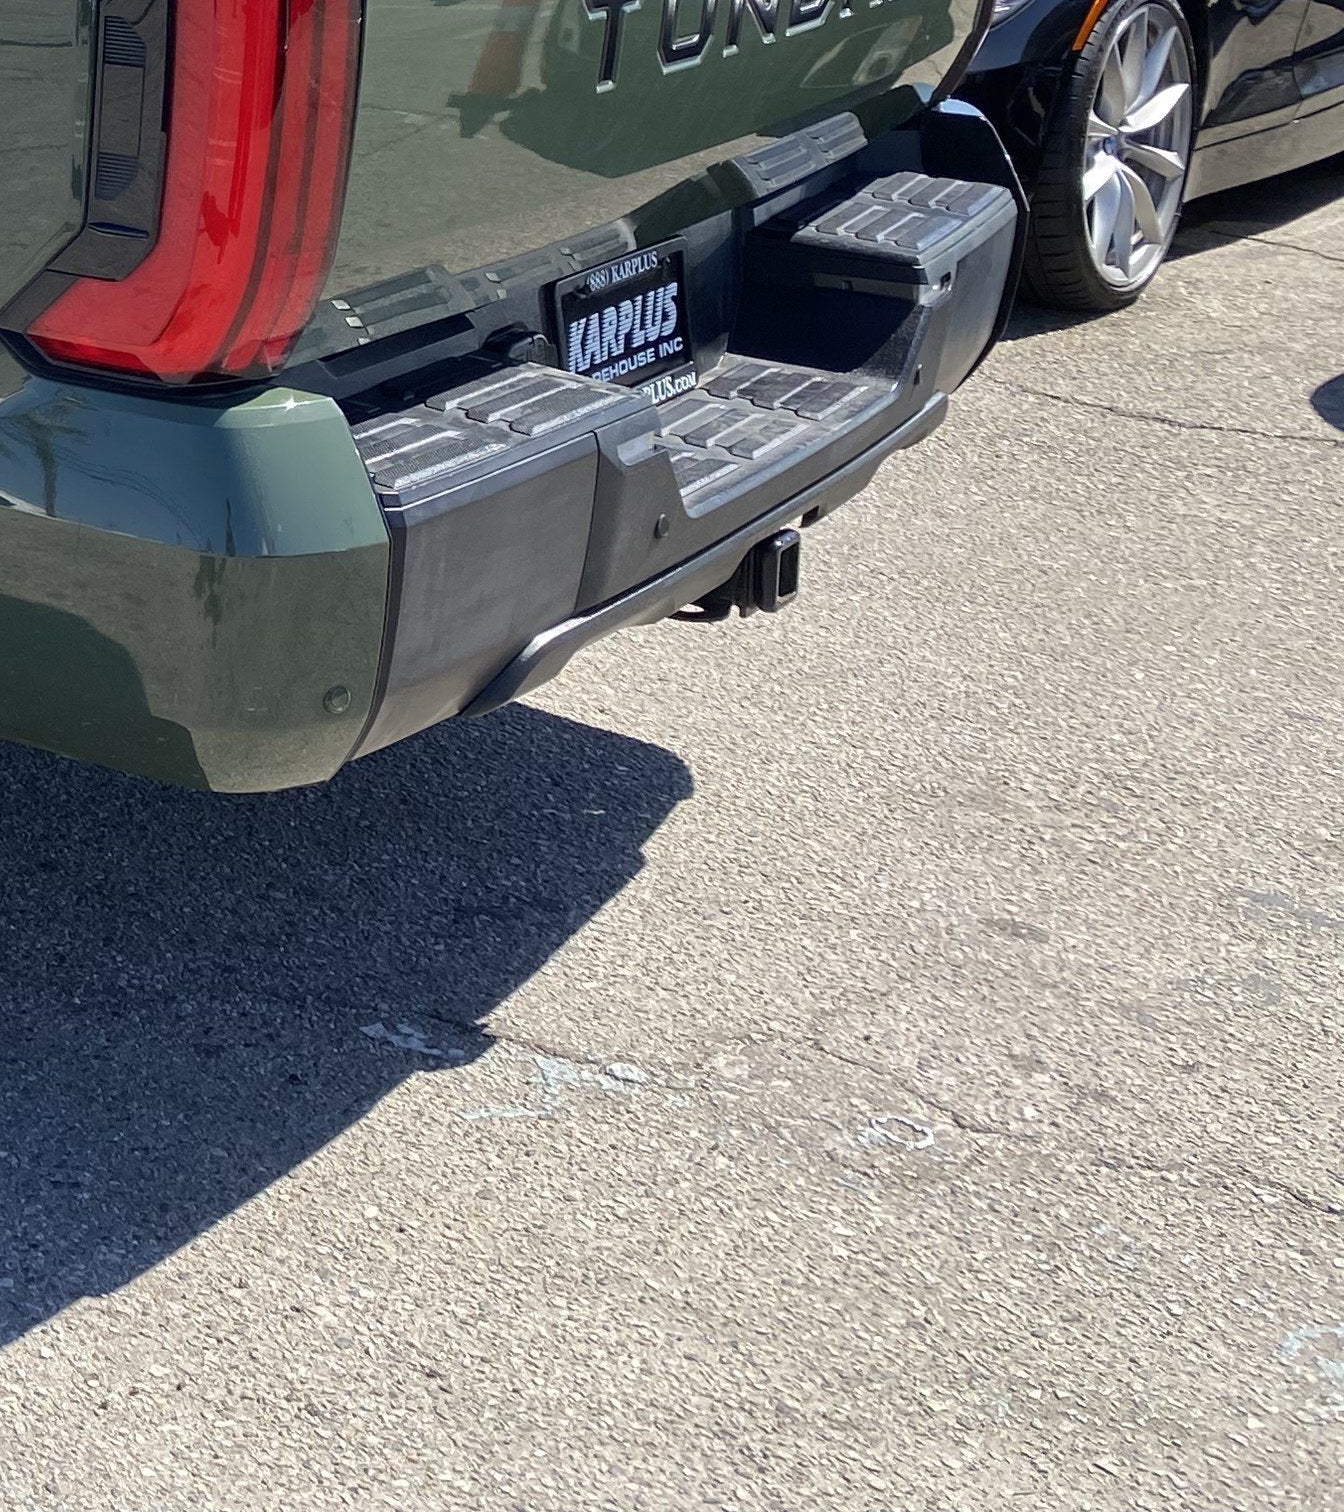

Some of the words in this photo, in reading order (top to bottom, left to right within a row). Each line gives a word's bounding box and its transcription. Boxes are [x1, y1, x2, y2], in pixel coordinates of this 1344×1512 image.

[611, 250, 658, 284] KARPLUS
[567, 281, 678, 374] KARPLUS
[658, 336, 684, 358] INC
